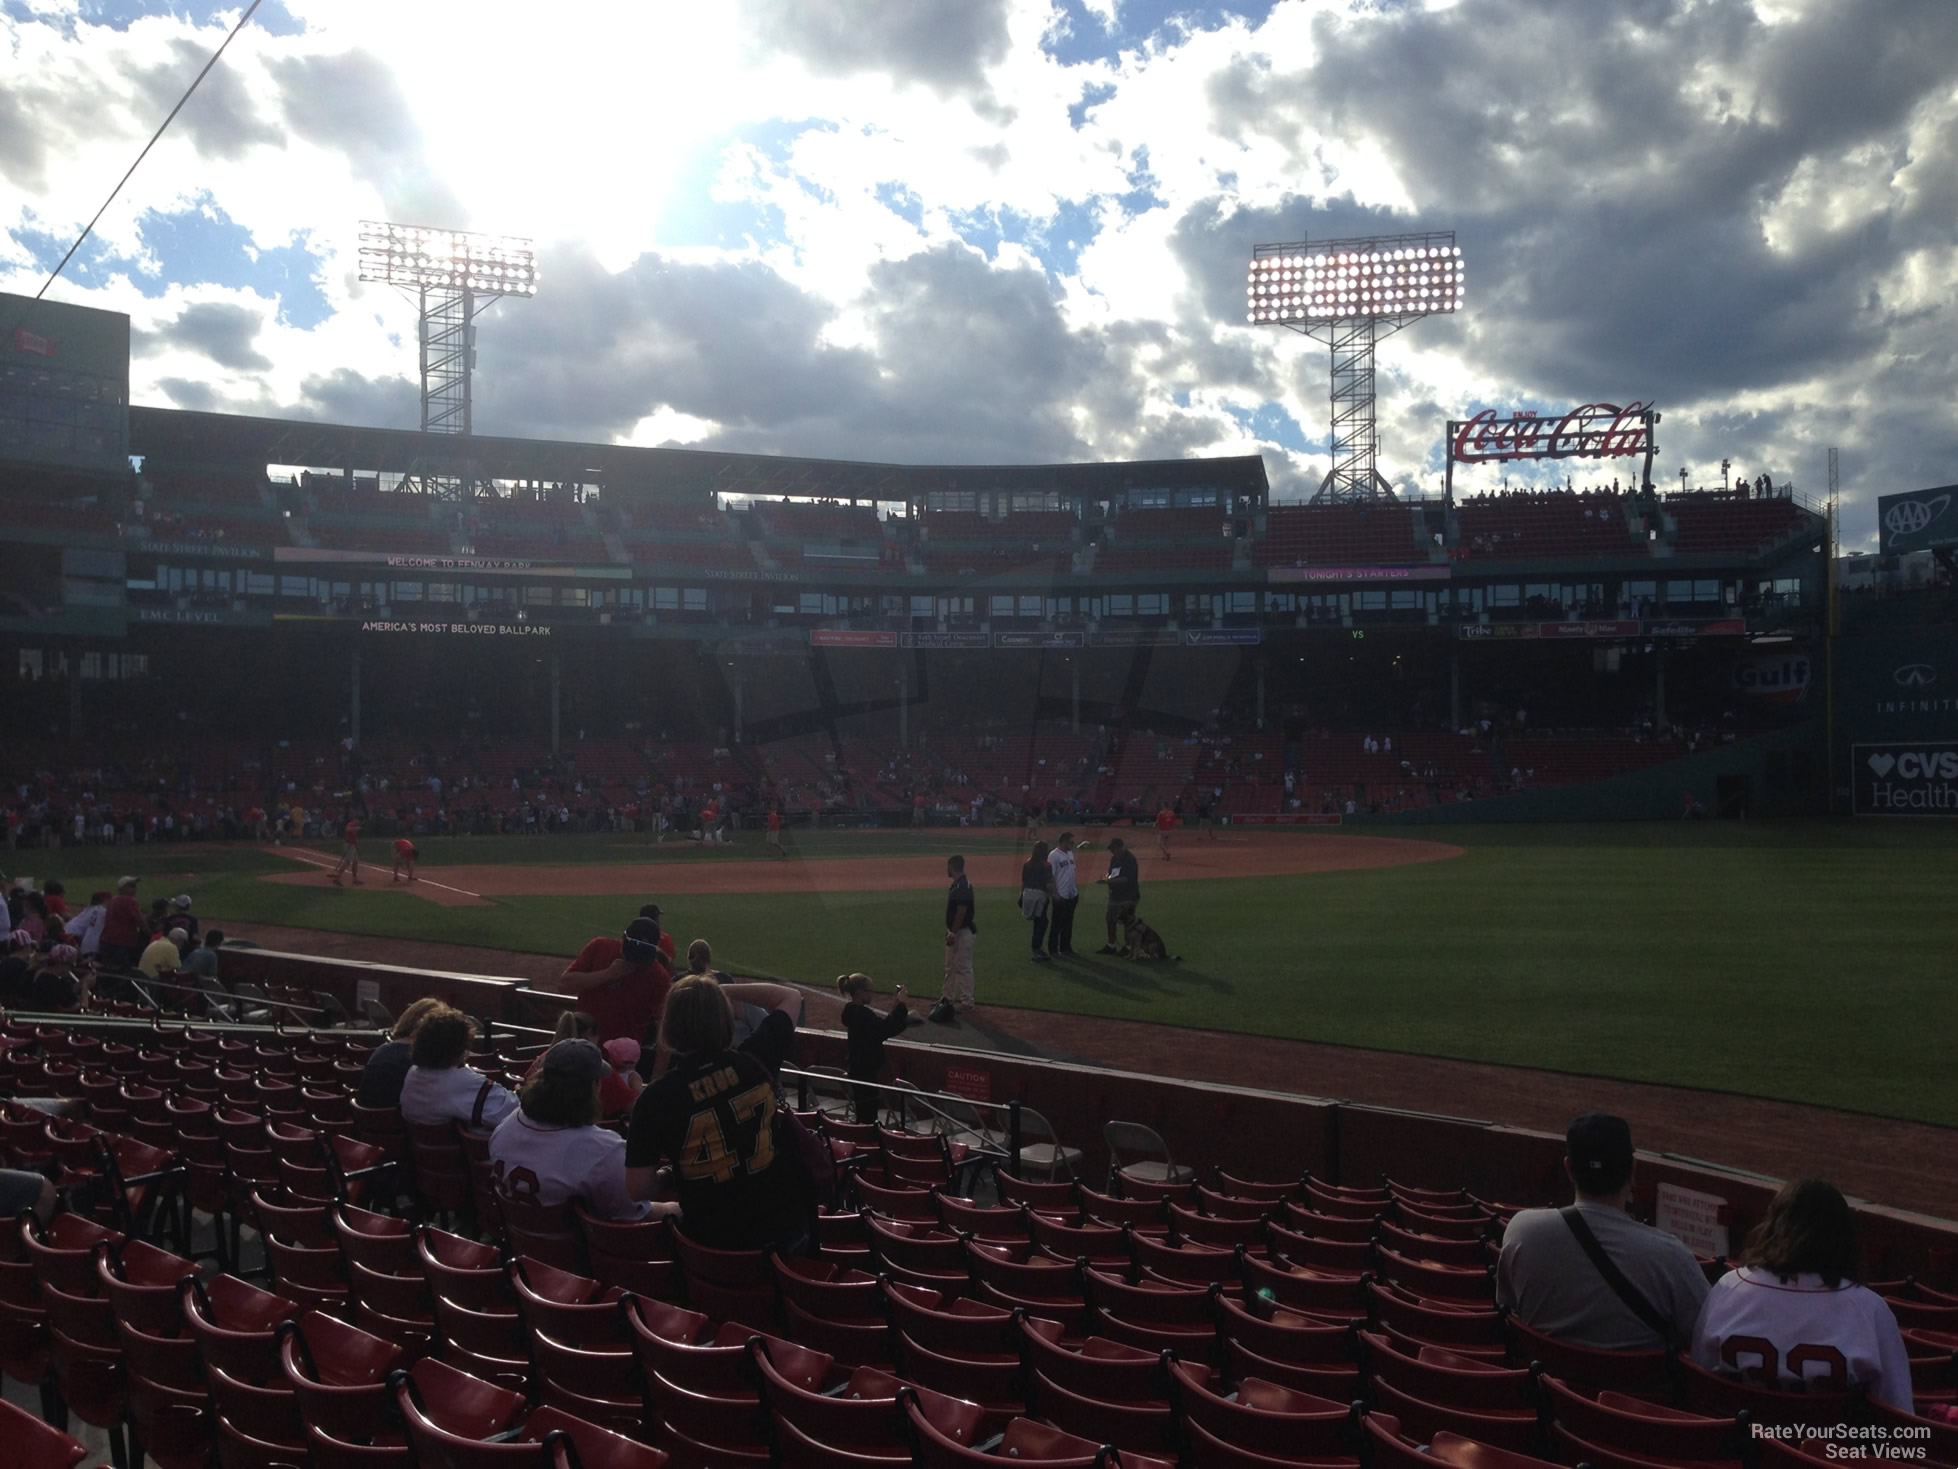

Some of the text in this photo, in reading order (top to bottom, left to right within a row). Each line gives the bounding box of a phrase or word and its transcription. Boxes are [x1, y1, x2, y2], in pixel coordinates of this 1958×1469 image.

[1513, 411, 1537, 419] ENJOY
[1889, 502, 1929, 533] AAA
[387, 556, 437, 568] WELCOME
[441, 558, 454, 569] TO
[1303, 567, 1409, 580] TONIGHT'S STARTERS
[140, 609, 220, 623] EMC LEVEL
[362, 621, 551, 636] AMERICA'S MOST BELOVED BALLPARK
[1352, 630, 1365, 640] VS
[1463, 625, 1492, 638] Tribe
[1735, 661, 1809, 686] Gulf
[1896, 752, 1958, 780] CVS
[1872, 781, 1958, 808] Health
[680, 1081, 777, 1184] 47
